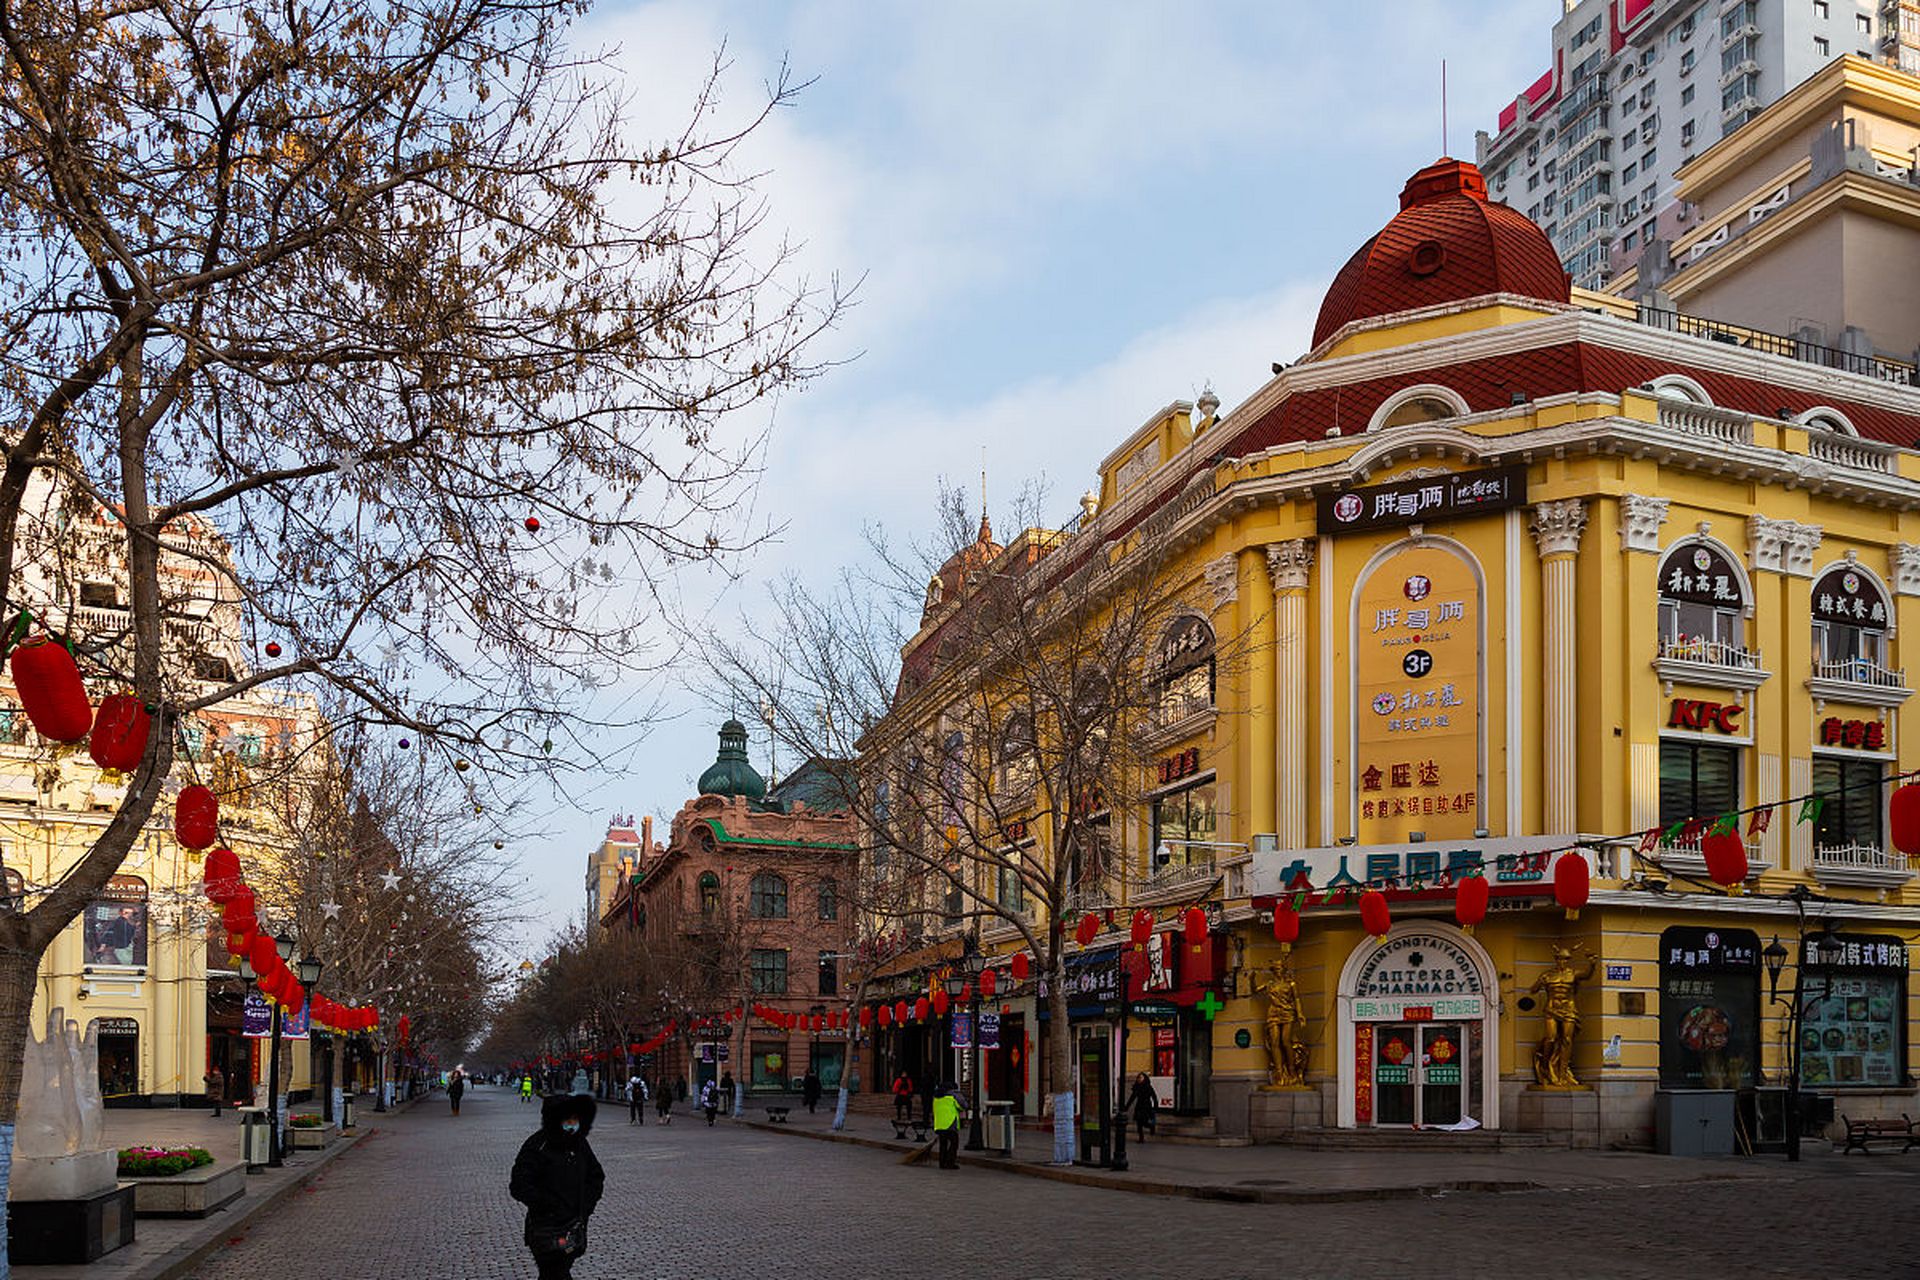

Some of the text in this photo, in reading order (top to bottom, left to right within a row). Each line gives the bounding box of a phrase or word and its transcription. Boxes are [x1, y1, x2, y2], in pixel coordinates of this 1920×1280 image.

[1372, 486, 1444, 519] 胖哥俩
[1372, 600, 1465, 634] 胖哥俩
[1405, 654, 1430, 673] 3F
[1669, 699, 1744, 732] KFC
[1822, 717, 1885, 748] 肯德基
[1361, 760, 1440, 792] 金旺达
[1369, 981, 1466, 995] PHARMACY
[1378, 969, 1456, 982] аптека
